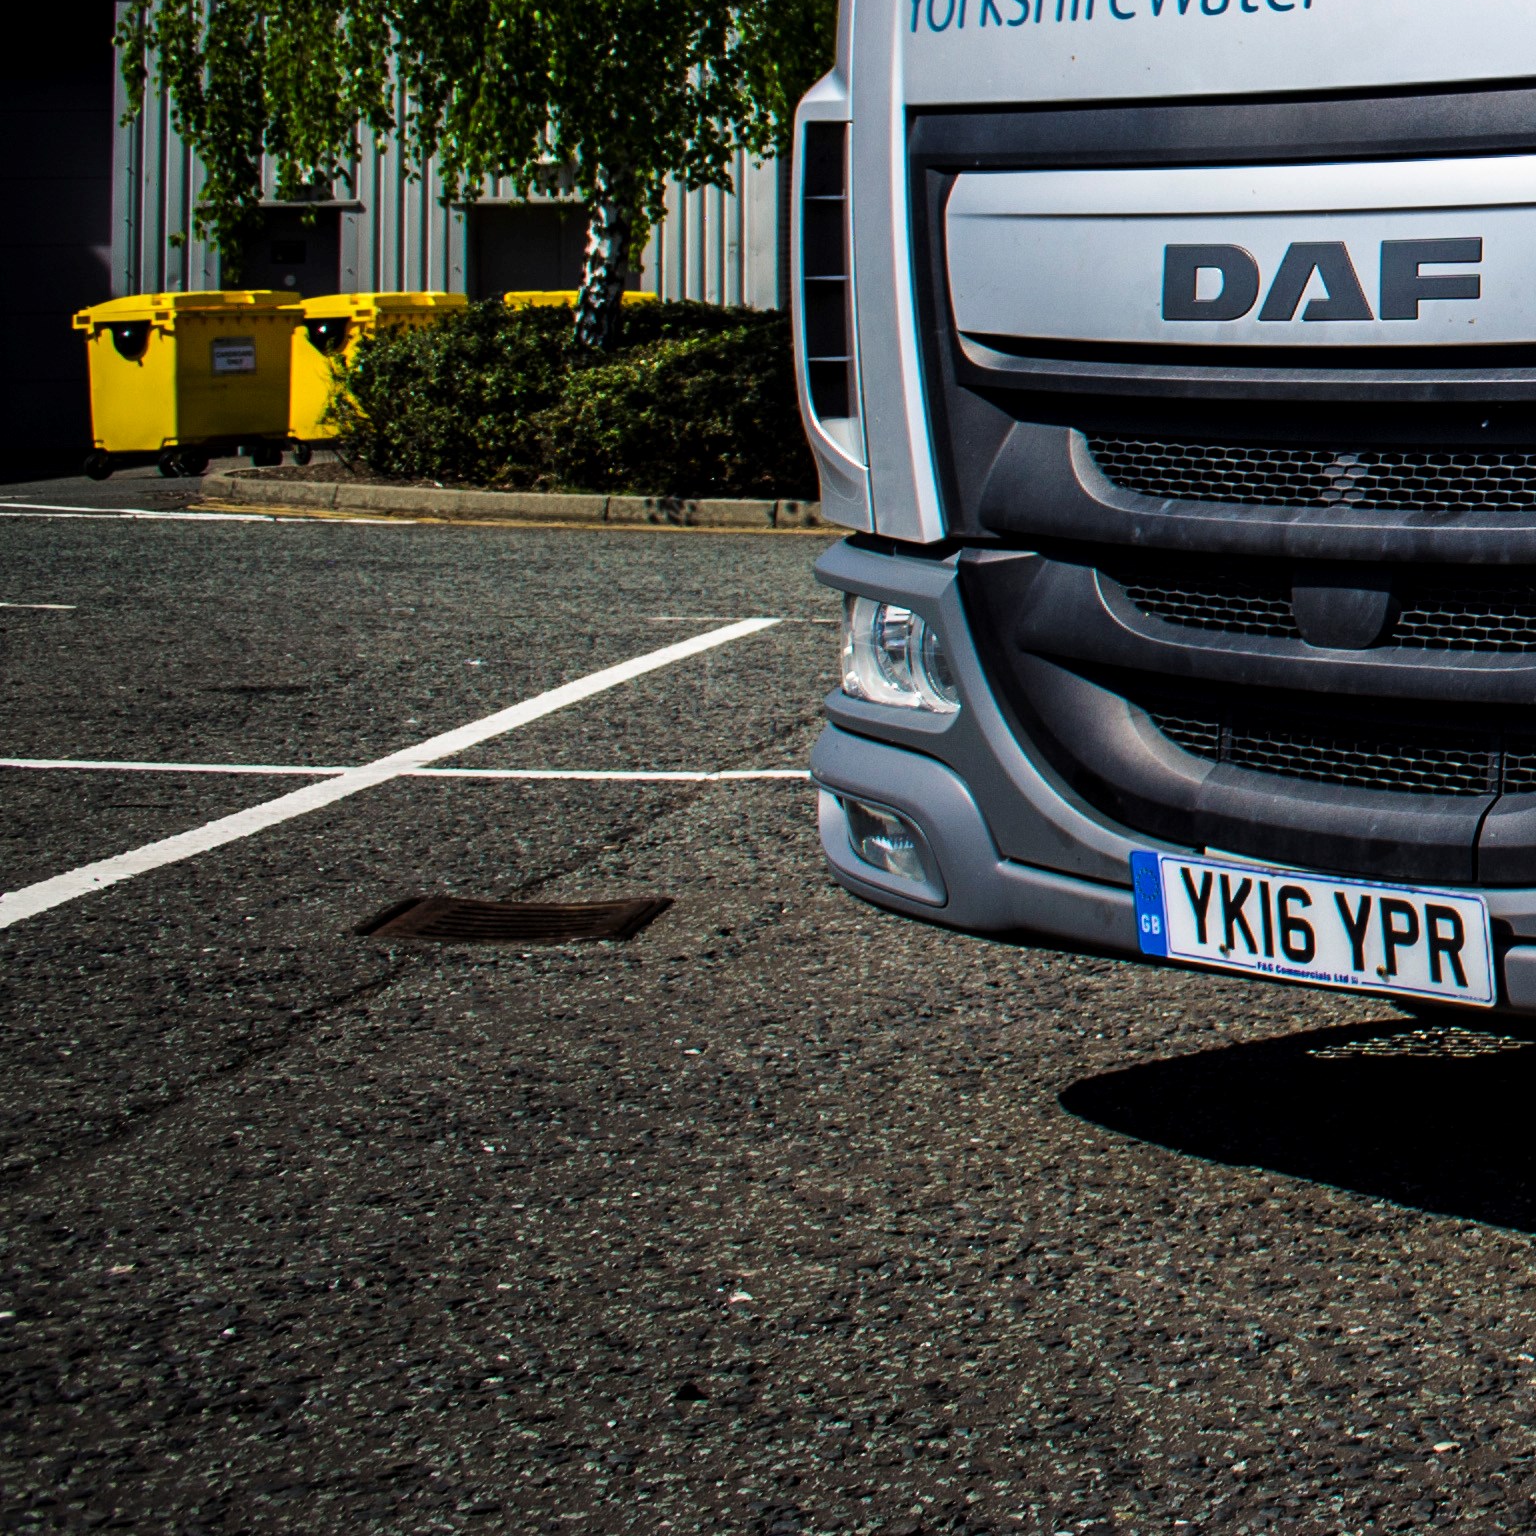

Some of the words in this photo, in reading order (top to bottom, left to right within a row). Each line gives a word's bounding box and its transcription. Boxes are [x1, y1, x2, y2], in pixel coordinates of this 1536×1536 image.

[1161, 237, 1484, 322] DAF
[1141, 914, 1160, 935] GB
[1180, 866, 1316, 964] YK16
[1334, 891, 1469, 988] YPR
[1275, 964, 1332, 982] Commercials
[1334, 973, 1349, 983] Ltd
